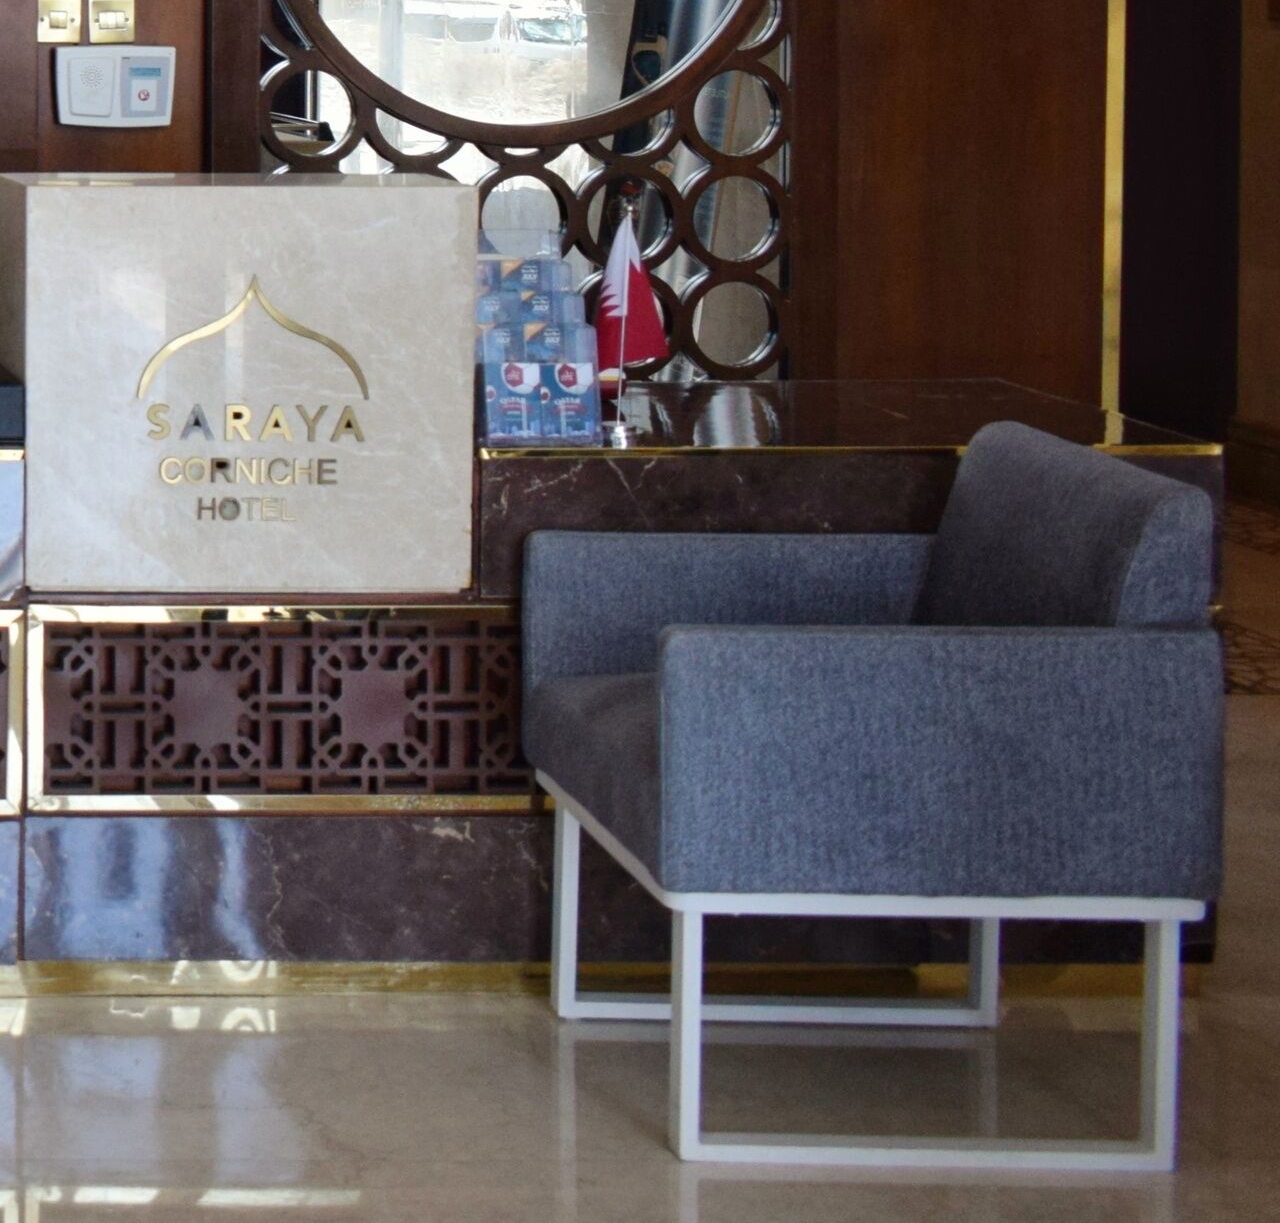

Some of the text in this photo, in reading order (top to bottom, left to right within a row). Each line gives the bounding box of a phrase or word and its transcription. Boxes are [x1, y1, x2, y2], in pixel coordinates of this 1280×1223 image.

[146, 403, 365, 442] SARAYA
[159, 457, 338, 486] CORNICHE
[196, 497, 297, 522] HOTEL
